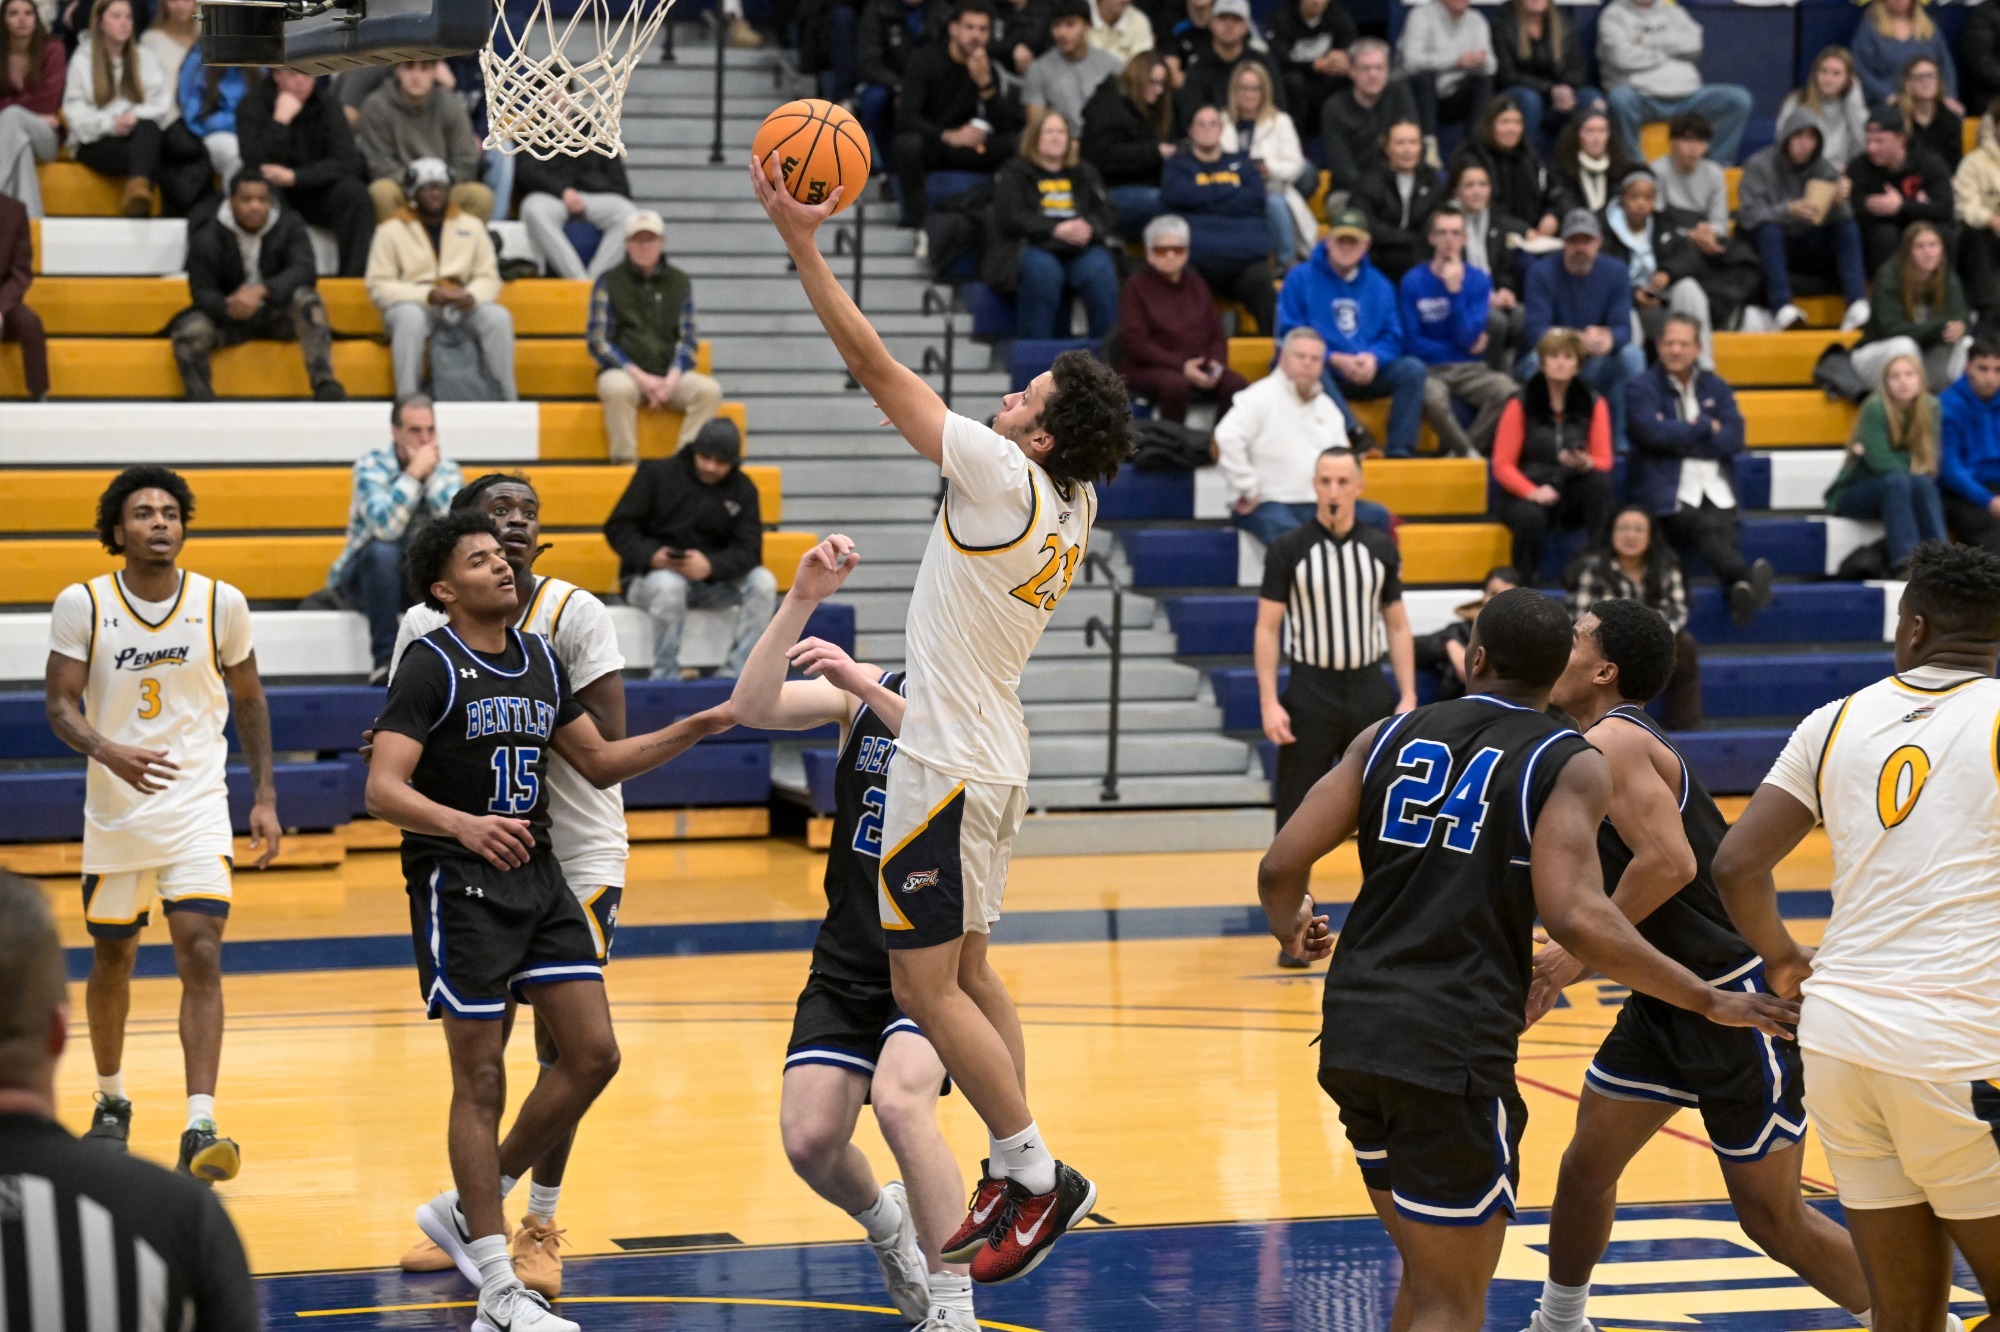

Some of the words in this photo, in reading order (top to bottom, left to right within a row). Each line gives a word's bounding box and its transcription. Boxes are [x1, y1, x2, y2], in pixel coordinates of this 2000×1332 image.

[1008, 533, 1080, 610] 23
[114, 646, 189, 669] PENMEN
[138, 677, 162, 720] 3
[488, 746, 540, 814] 15
[1378, 738, 1504, 854] 24
[1877, 744, 1931, 830] 0
